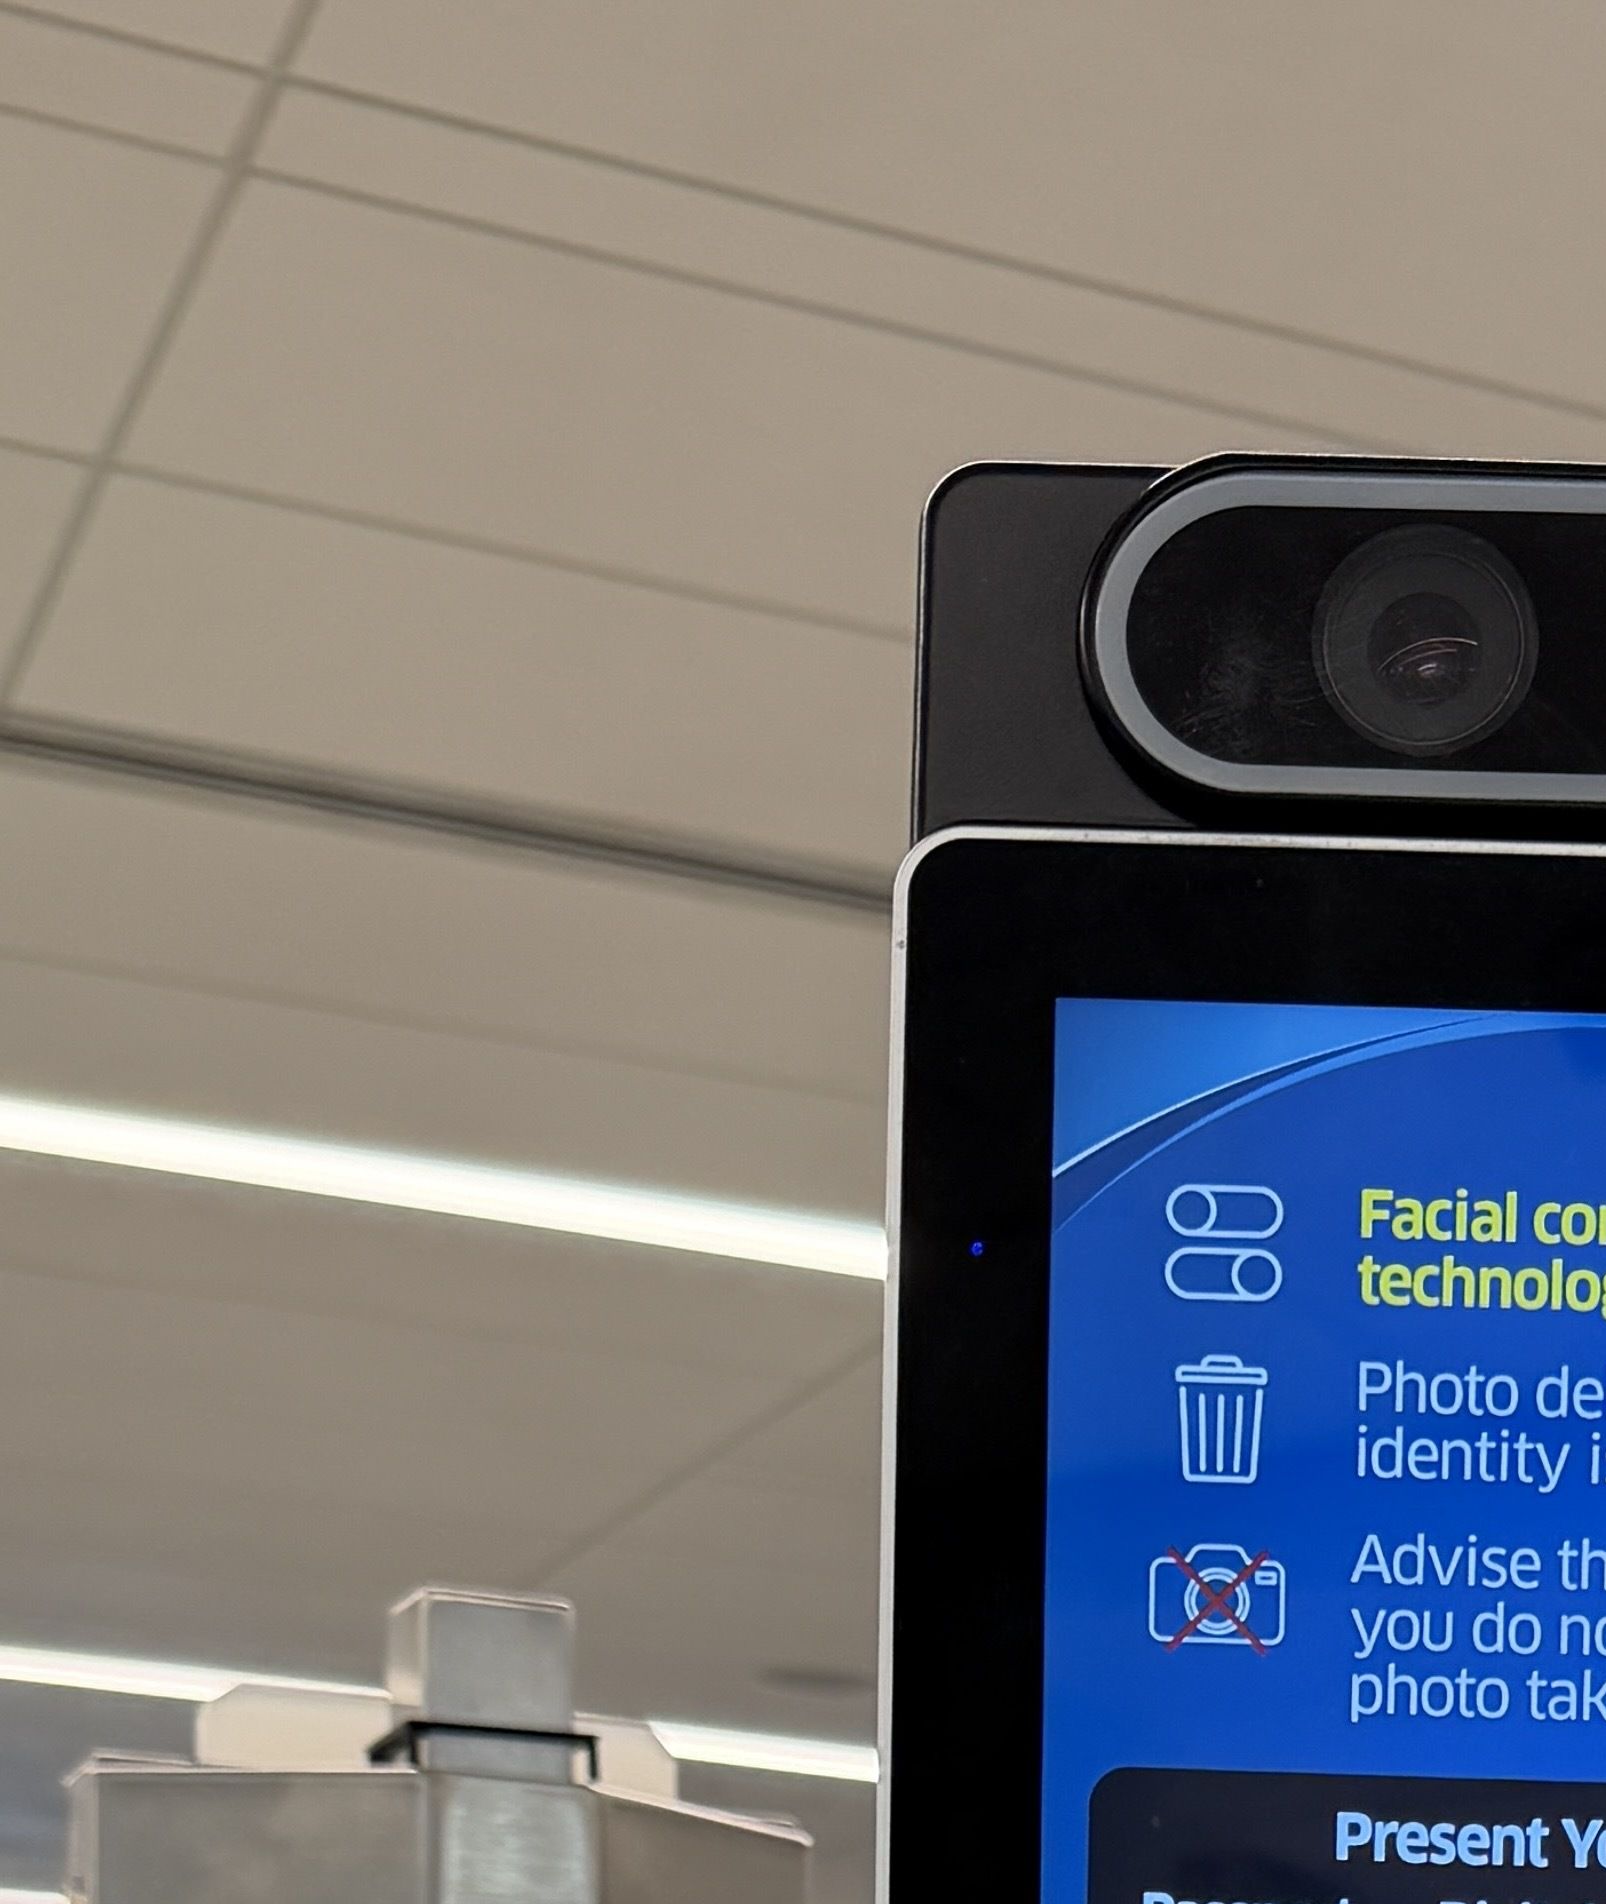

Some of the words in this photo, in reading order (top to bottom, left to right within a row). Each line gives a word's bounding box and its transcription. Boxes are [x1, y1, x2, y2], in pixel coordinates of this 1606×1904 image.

[1360, 1188, 1518, 1243] Facial
[1358, 1359, 1519, 1417] Photo
[1357, 1424, 1571, 1493] identity
[1350, 1532, 1542, 1590] Advise
[1350, 1608, 1454, 1659] you
[1472, 1600, 1542, 1655] do
[1350, 1662, 1510, 1723] photo
[1335, 1811, 1550, 1868] Present
